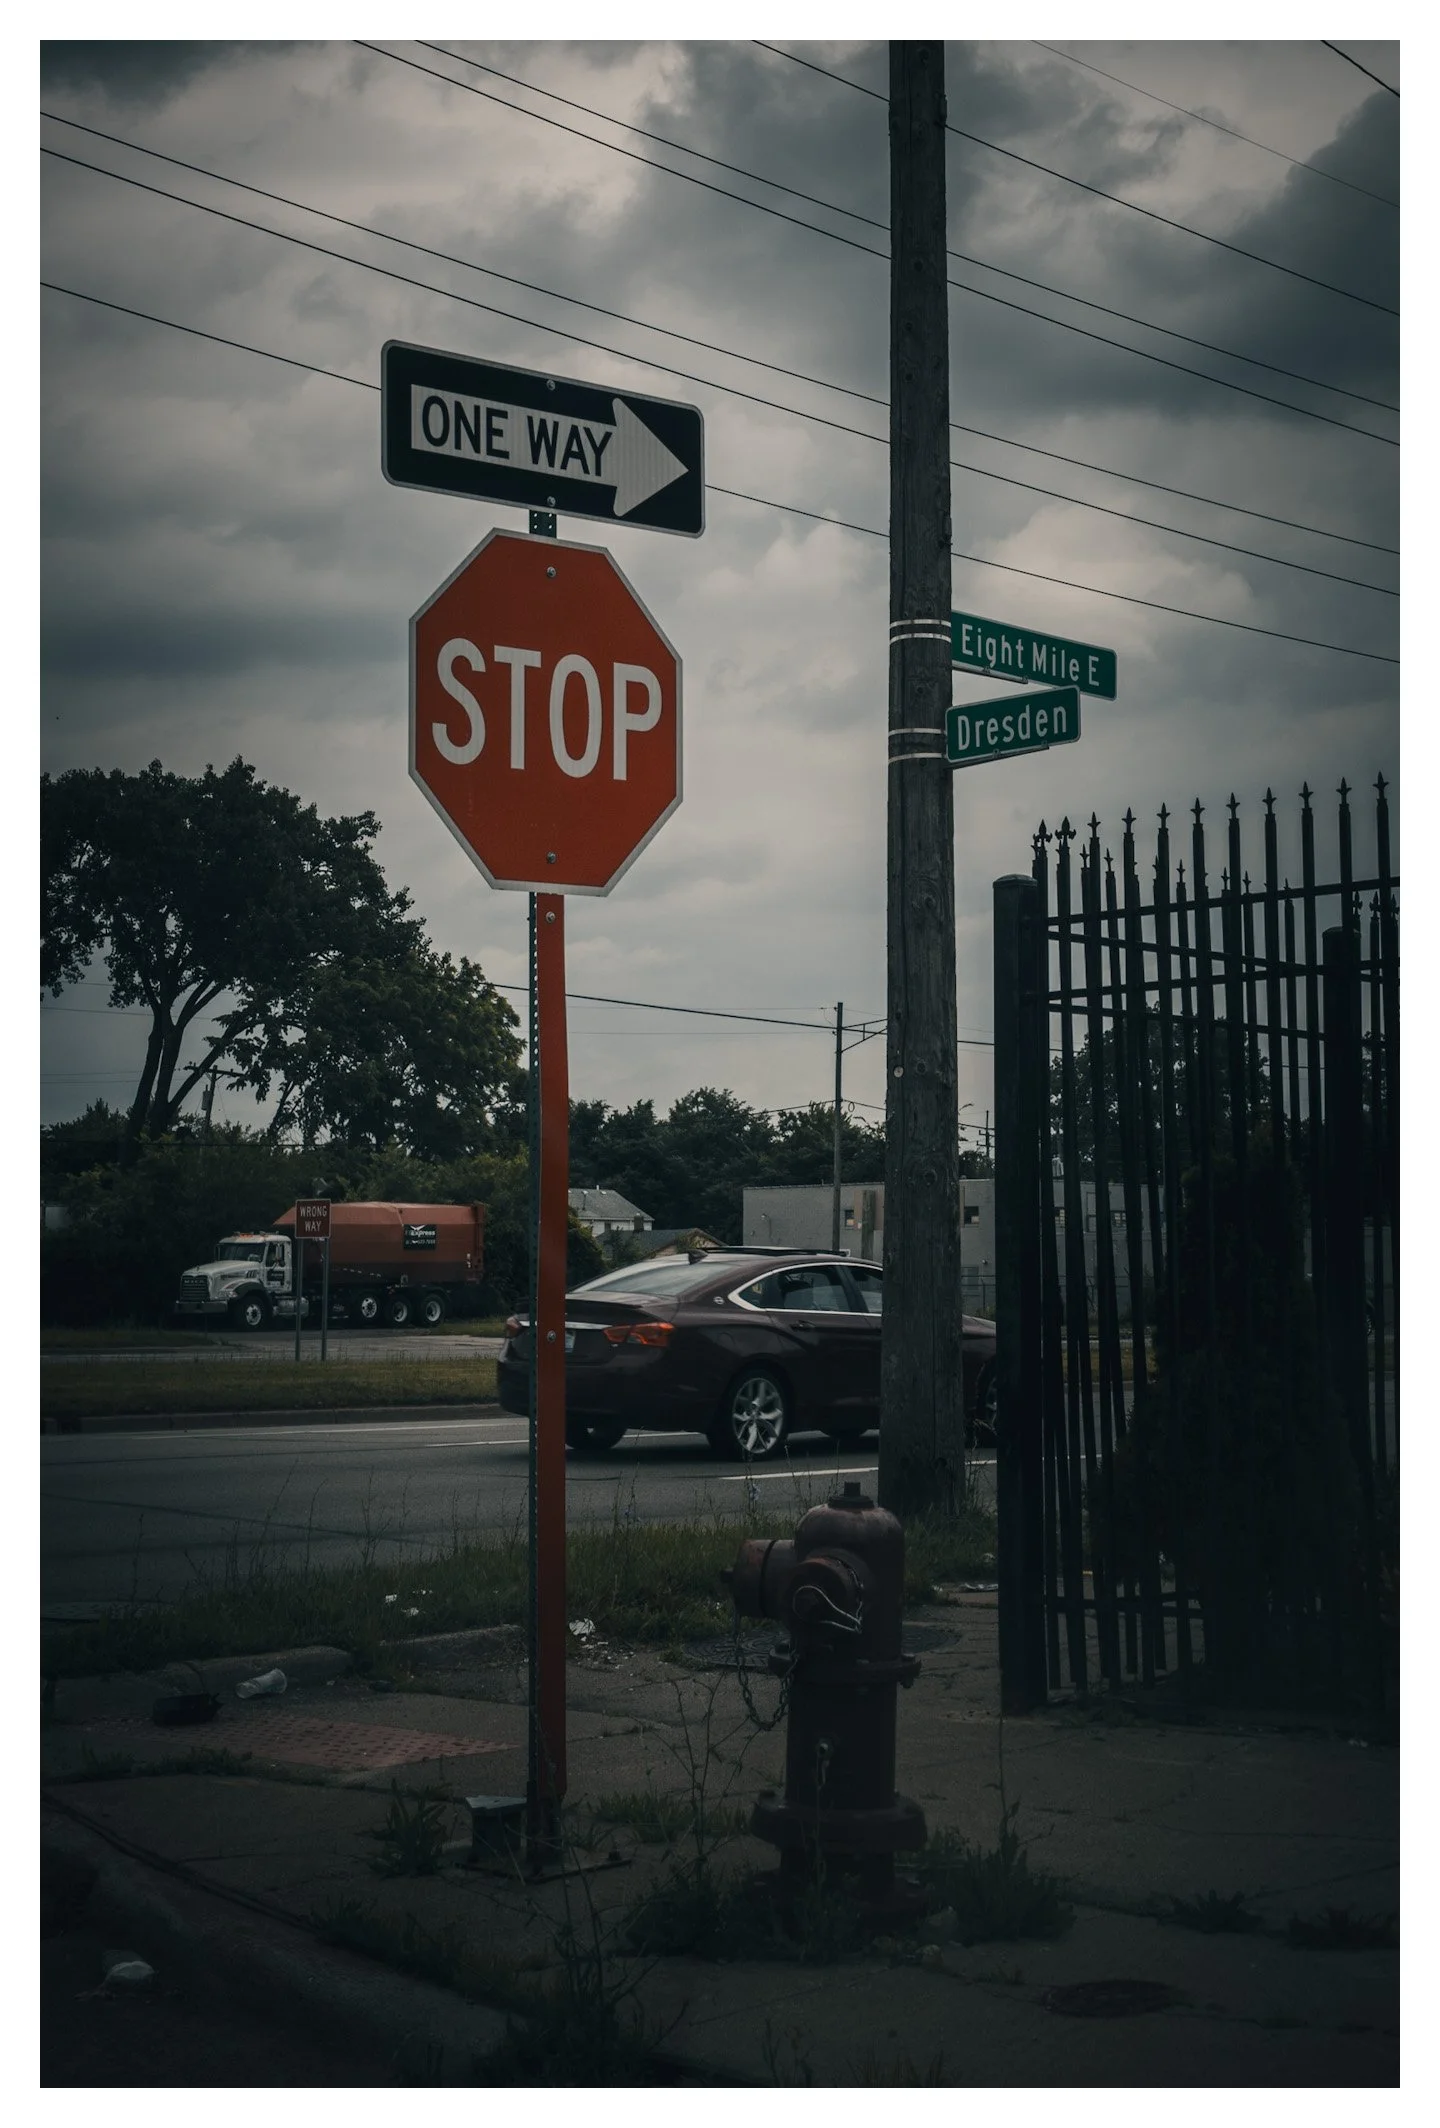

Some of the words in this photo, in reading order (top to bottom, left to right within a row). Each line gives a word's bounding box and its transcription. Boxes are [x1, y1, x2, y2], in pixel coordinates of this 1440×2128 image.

[421, 394, 511, 461] ONE
[527, 414, 614, 478] WAY
[961, 623, 1024, 669] Eight
[1032, 641, 1080, 682] Mile
[1088, 655, 1100, 687] E
[432, 637, 663, 781] STOP
[957, 703, 1067, 751] Dresden
[300, 1205, 328, 1218] WRONG
[304, 1220, 322, 1232] WAY
